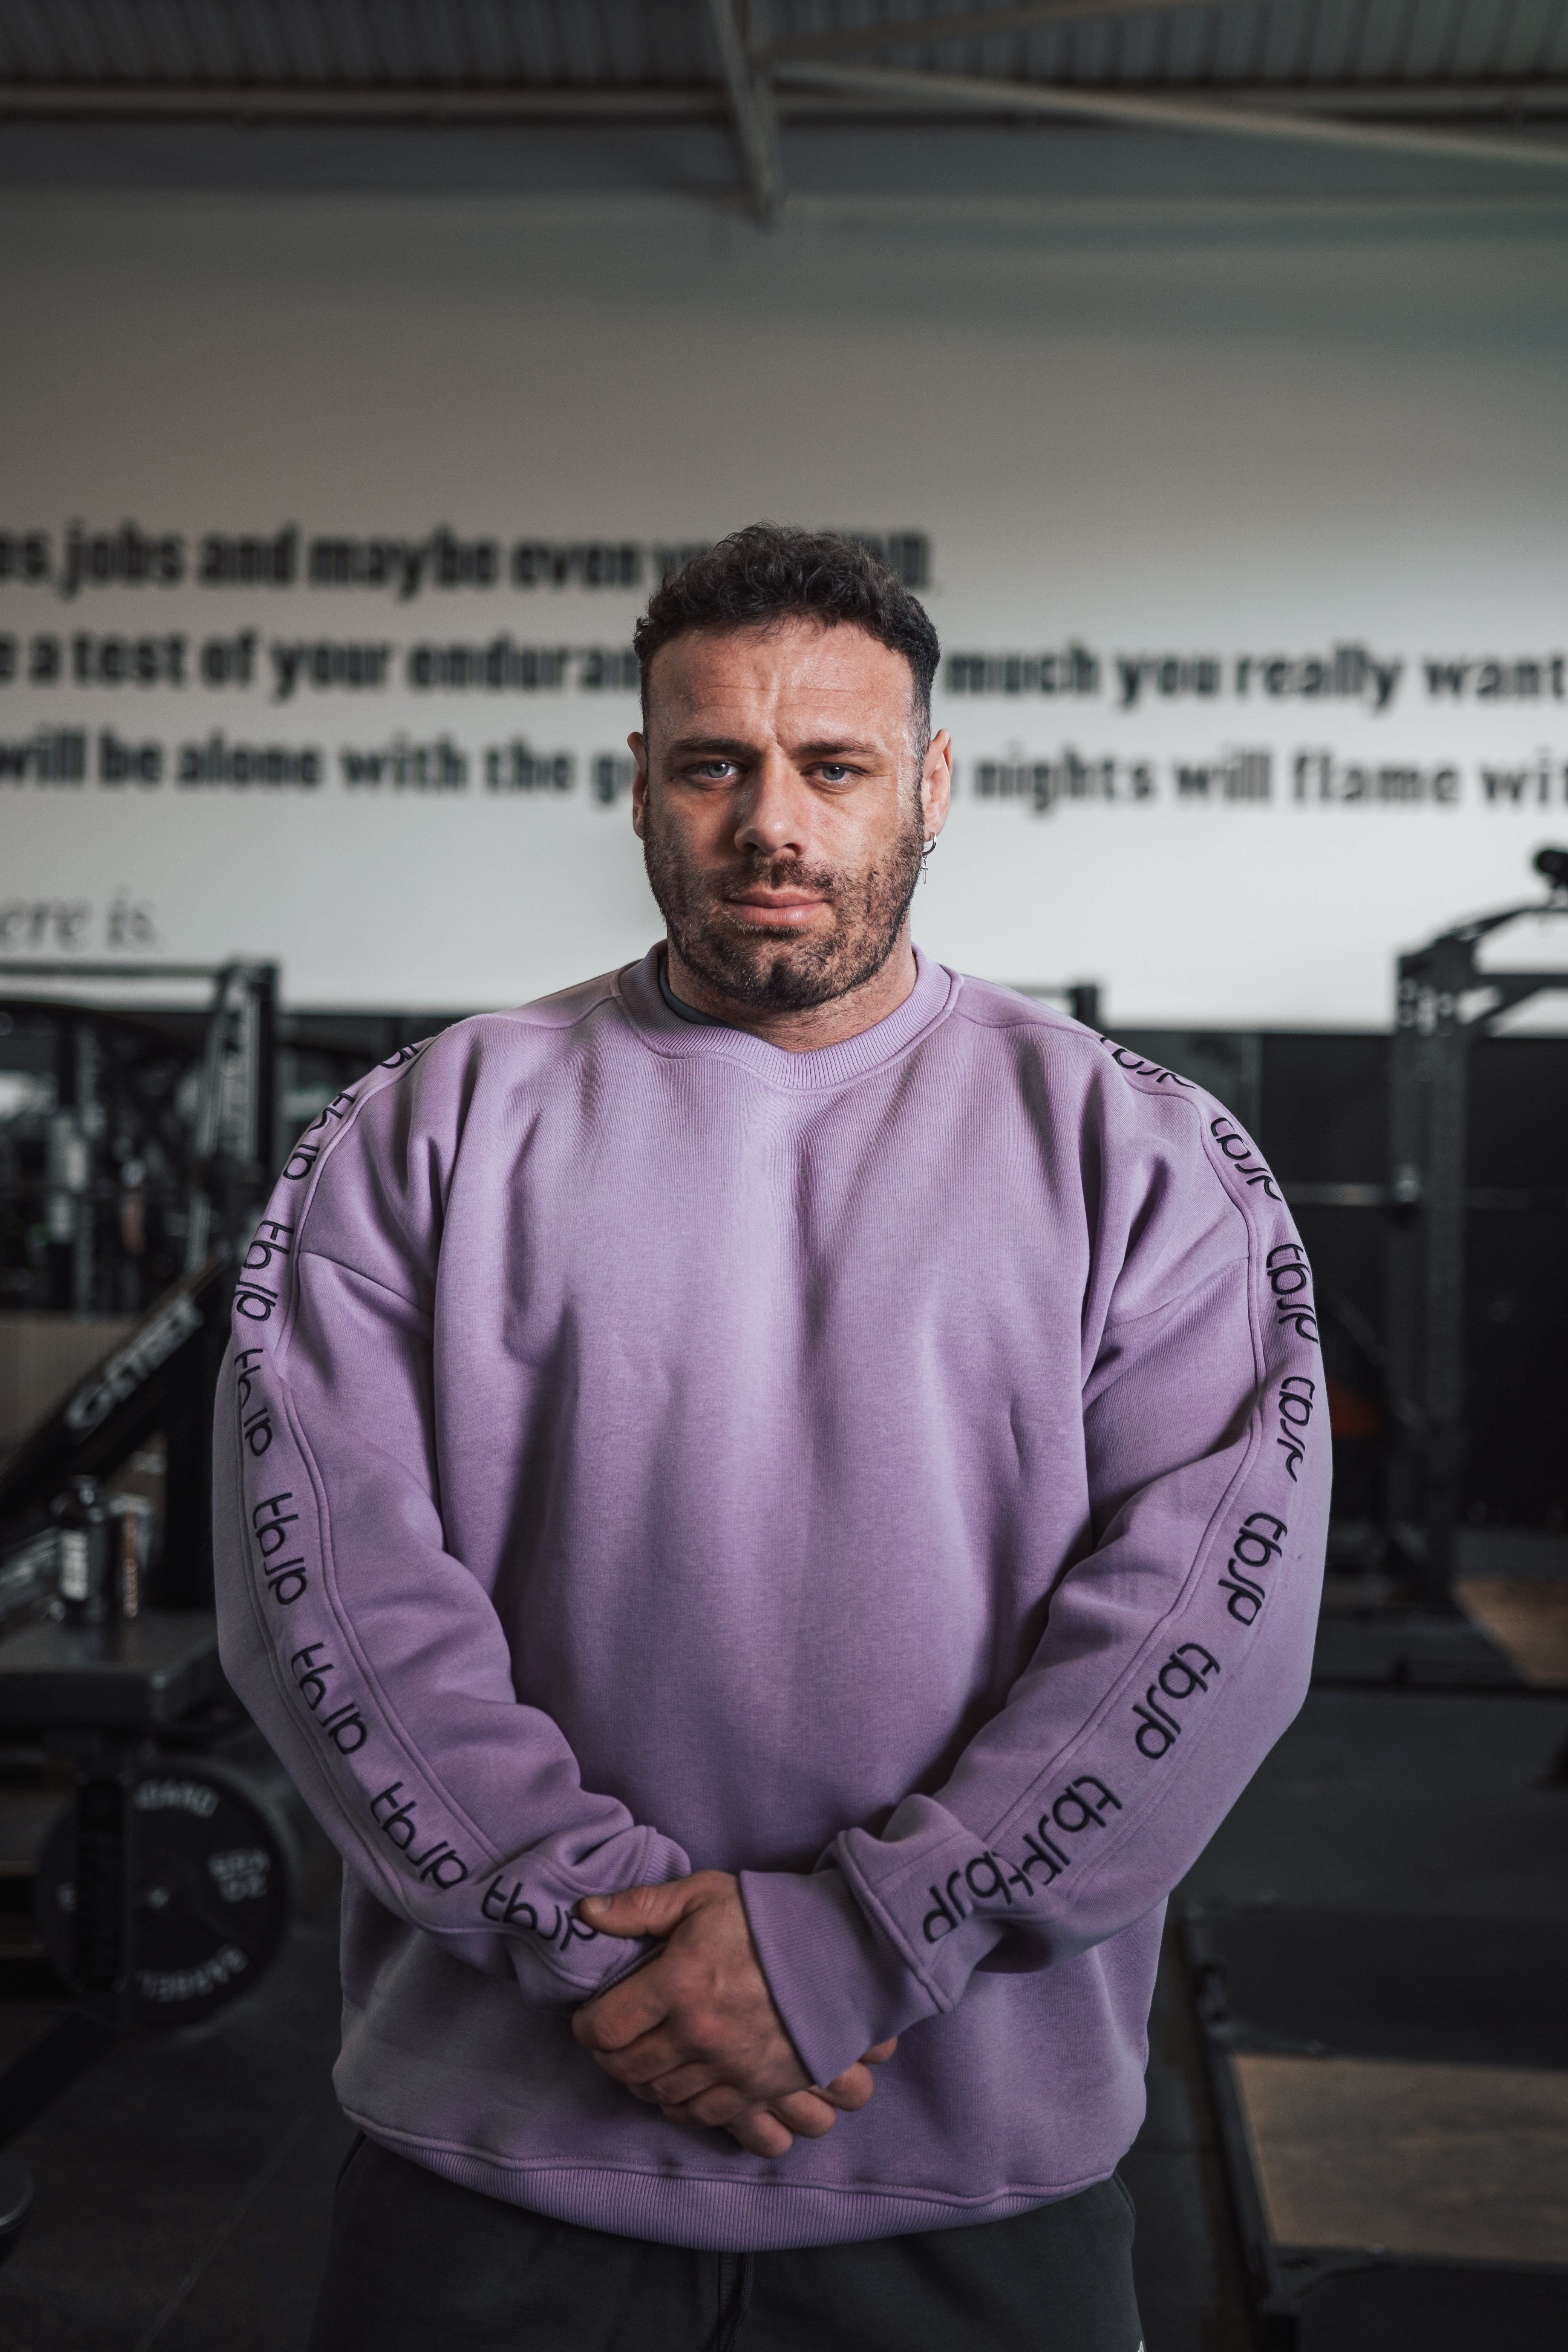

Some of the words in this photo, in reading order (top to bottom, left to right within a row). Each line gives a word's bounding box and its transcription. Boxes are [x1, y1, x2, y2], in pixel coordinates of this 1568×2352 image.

[60, 516, 184, 600] jobs
[198, 521, 298, 587] and
[308, 522, 498, 600] maybe
[512, 537, 642, 589] even
[32, 634, 60, 685] a
[75, 629, 184, 689] test
[201, 624, 257, 689] of
[272, 640, 390, 704] your
[408, 629, 641, 693] enduran
[945, 638, 1101, 697] much
[1115, 649, 1221, 710] you
[1236, 637, 1403, 715] really
[1423, 653, 1568, 702] want
[98, 727, 162, 788] be
[176, 729, 320, 789] alone
[340, 730, 469, 792] with
[484, 732, 574, 793] the
[975, 743, 1152, 817] nights
[1174, 743, 1272, 802] will
[1296, 751, 1459, 806] flame
